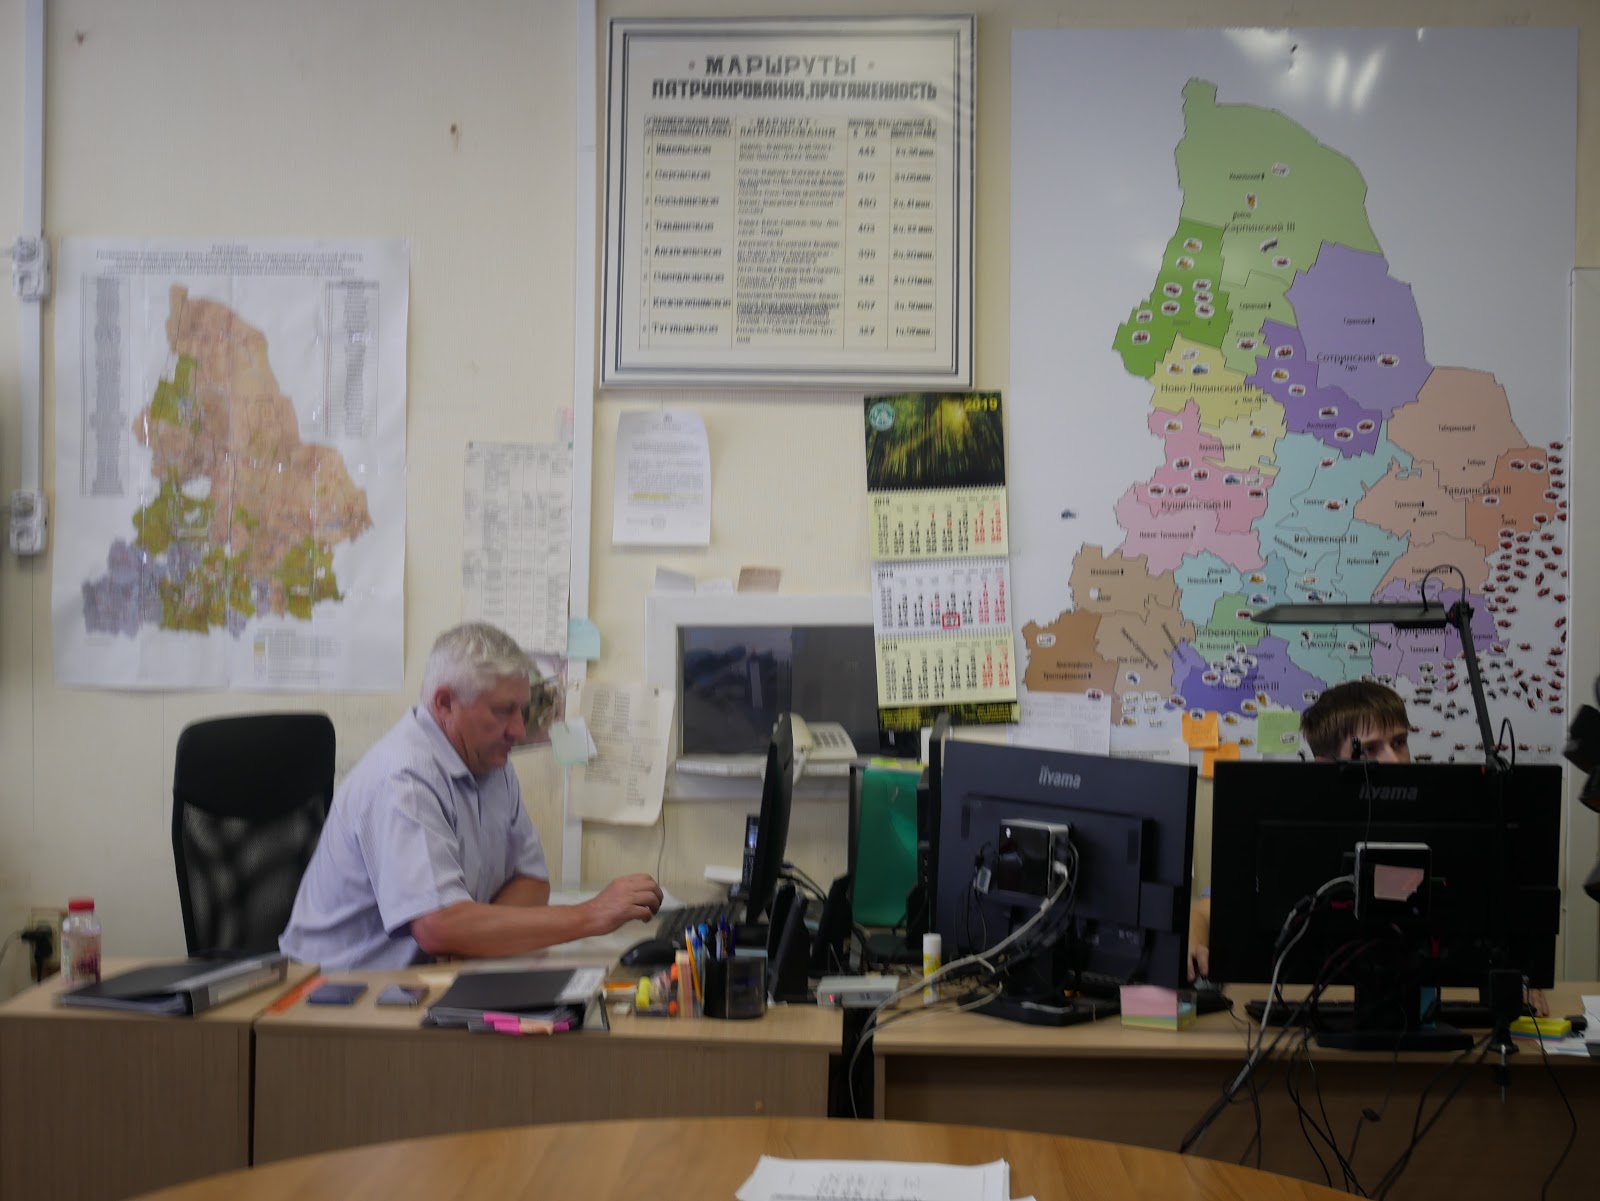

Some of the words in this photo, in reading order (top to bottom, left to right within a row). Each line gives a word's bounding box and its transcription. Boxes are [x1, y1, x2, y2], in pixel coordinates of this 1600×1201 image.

[705, 54, 857, 77] МАРШРУТЫ
[1224, 222, 1284, 235] Карпинский
[1286, 221, 1296, 233] III
[1316, 352, 1376, 364] Сотринский
[964, 397, 998, 413] 2019
[1443, 484, 1501, 495] Тавдинский
[1503, 485, 1512, 495] III
[1038, 764, 1082, 790] iiyama
[1358, 784, 1419, 802] iiyama
